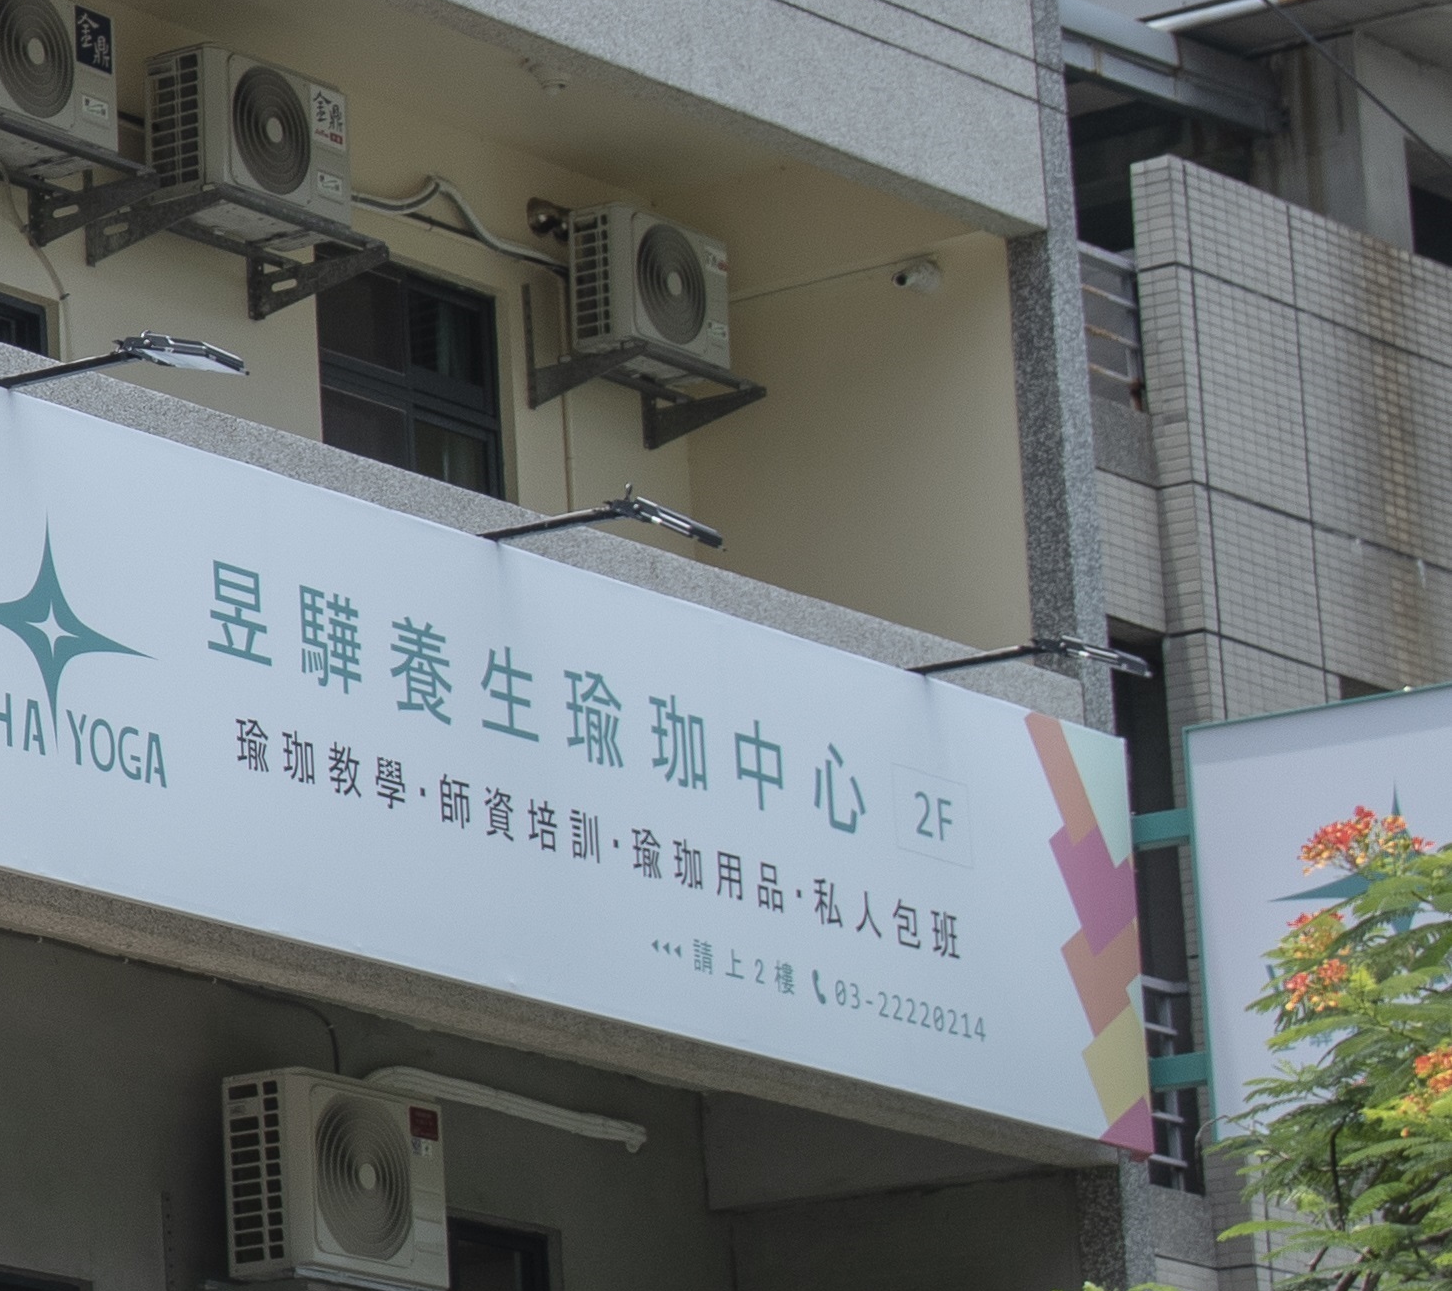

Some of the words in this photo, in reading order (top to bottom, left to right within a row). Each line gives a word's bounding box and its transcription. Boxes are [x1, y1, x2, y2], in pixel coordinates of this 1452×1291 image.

[207, 559, 866, 835] 昱驊養生瑜珈中心
[66, 709, 168, 789] YOGA
[914, 791, 954, 842] 2F
[693, 938, 796, 996] 請上2樓
[834, 979, 987, 1042] 03-22220214
